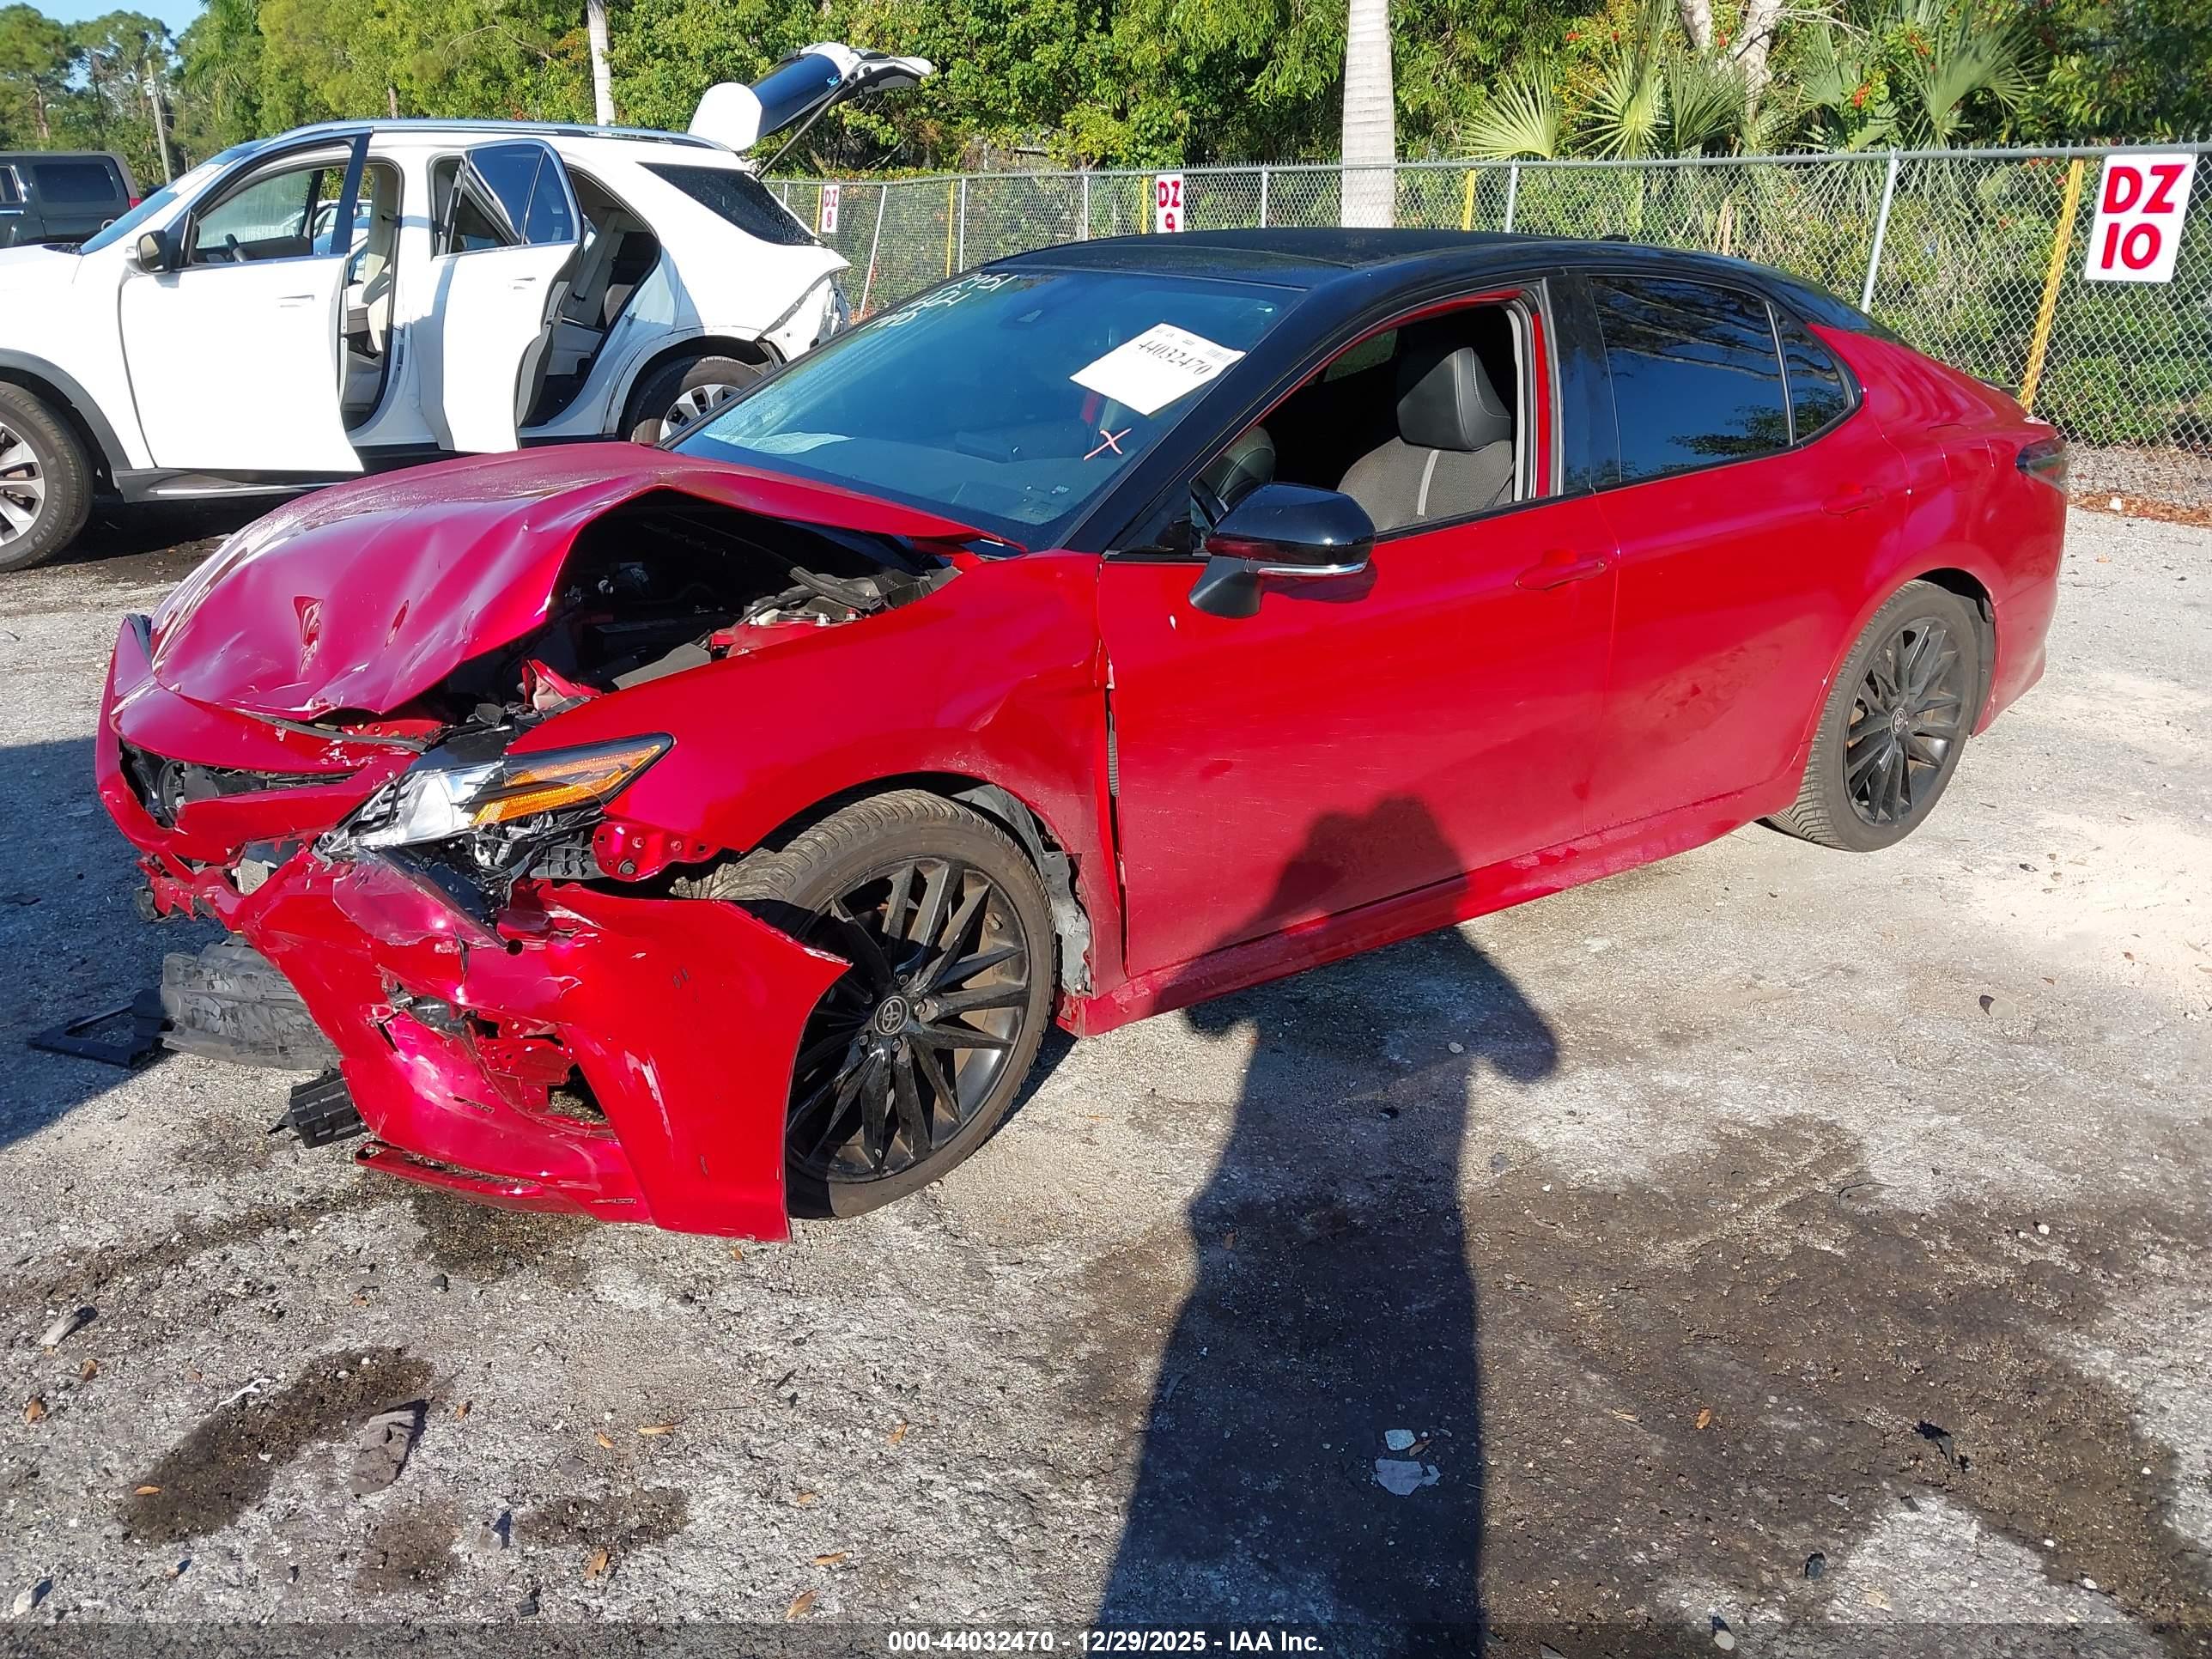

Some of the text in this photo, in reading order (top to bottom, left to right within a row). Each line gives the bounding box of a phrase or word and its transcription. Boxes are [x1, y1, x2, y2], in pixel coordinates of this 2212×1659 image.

[824, 189, 838, 207] DZ
[1158, 180, 1181, 208] DZ
[2102, 164, 2187, 214] DZ
[826, 210, 832, 228] 8
[1165, 212, 1175, 233] 9
[2101, 222, 2161, 270] 10
[1138, 340, 1213, 375] 44032470
[33, 483, 63, 545] MICHELIN
